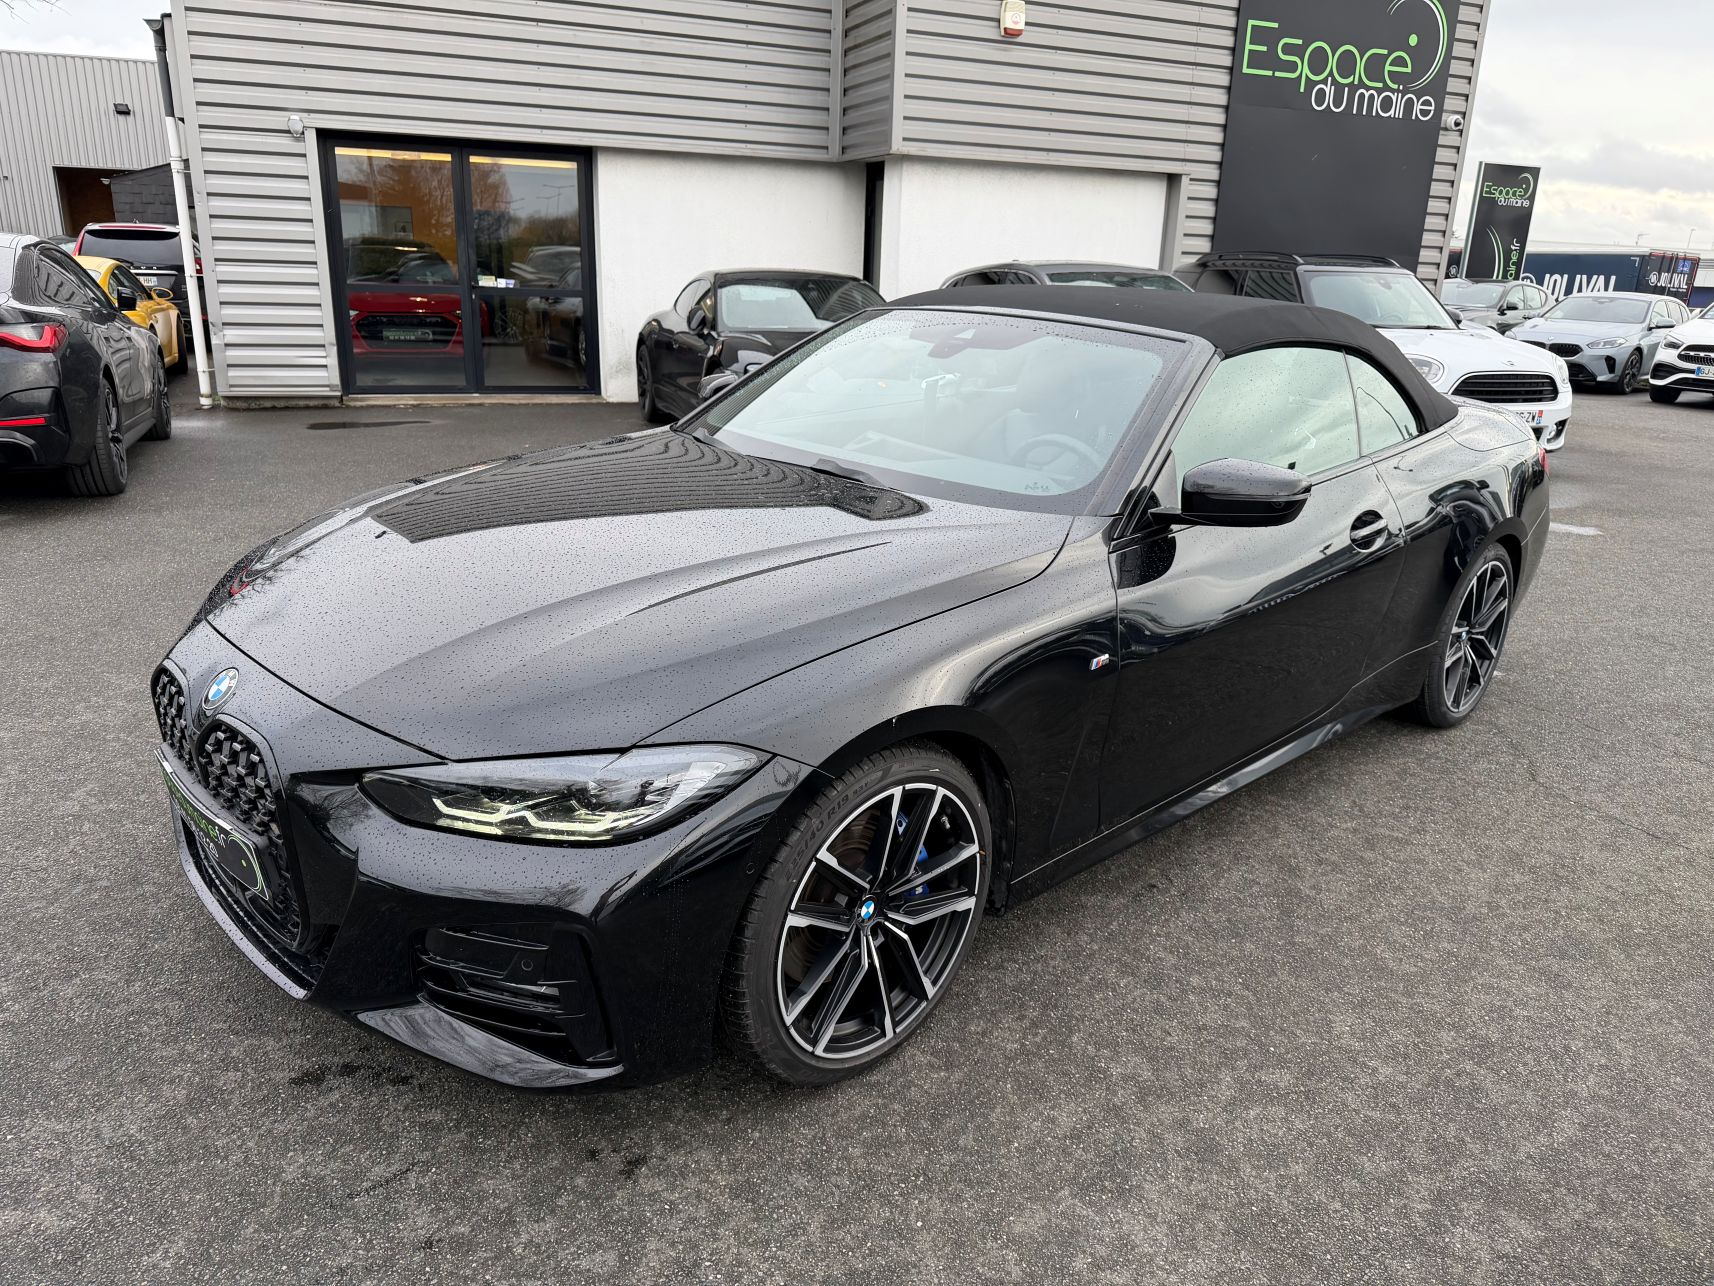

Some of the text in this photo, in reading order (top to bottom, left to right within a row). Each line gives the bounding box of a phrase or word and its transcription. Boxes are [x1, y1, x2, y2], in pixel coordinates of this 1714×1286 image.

[1242, 19, 1412, 92] Espace
[1310, 77, 1435, 121] du maine
[1483, 182, 1525, 200] Espace
[1507, 198, 1530, 208] maine
[1700, 367, 1714, 376] GJ-
